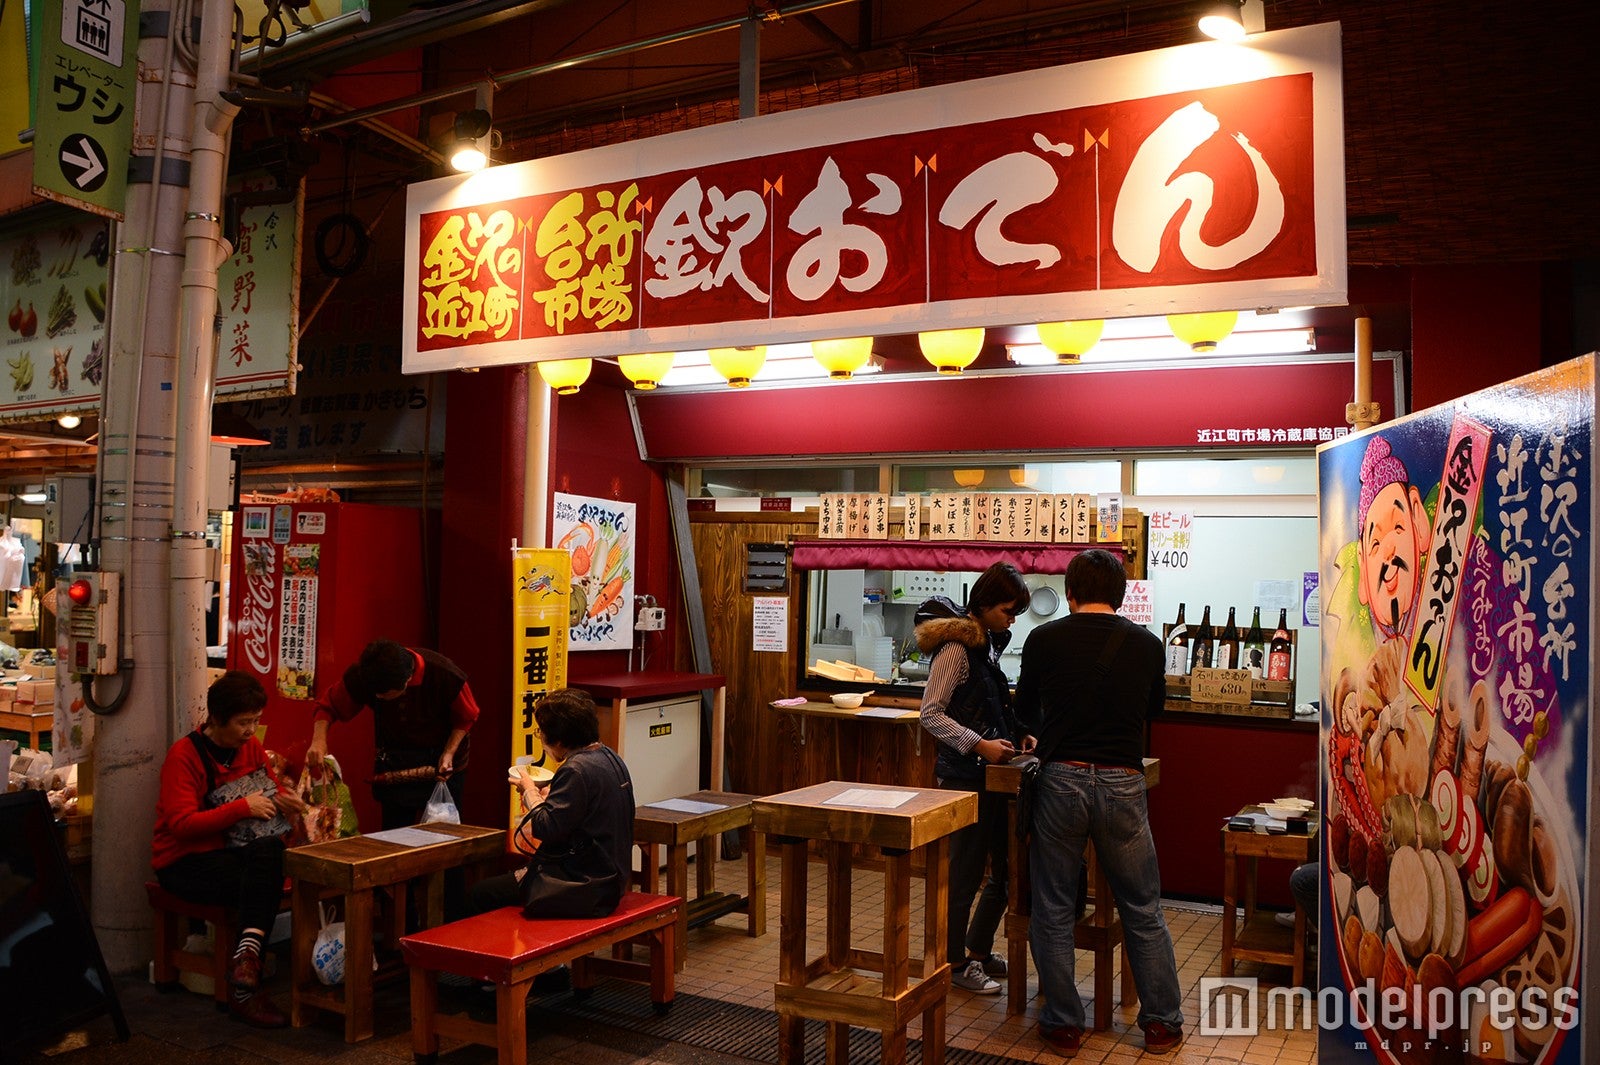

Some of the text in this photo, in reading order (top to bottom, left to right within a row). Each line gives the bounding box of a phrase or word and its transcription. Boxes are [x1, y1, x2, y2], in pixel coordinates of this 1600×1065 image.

[55, 54, 124, 89] エレベーター
[54, 74, 124, 125] ウシ
[644, 101, 1285, 303] 金沢おでん
[264, 211, 279, 251] 金沢
[1197, 426, 1356, 443] 近江町市場冷蔵庫協同
[822, 497, 831, 534] もち巾着
[862, 498, 872, 534] がんも
[876, 497, 886, 532] 牛スジ串
[908, 498, 917, 535] じゃがいも
[932, 498, 942, 534] 大根
[947, 497, 957, 534] ごぼ天
[977, 497, 987, 535] ばい貝
[992, 497, 1002, 535] たけのこ
[1008, 497, 1017, 537] 糸こんにゃく
[1023, 498, 1032, 536] コンニャク
[1040, 498, 1050, 536] 赤巻
[1059, 498, 1069, 536] ちくわ
[1077, 498, 1086, 536] たまご
[1151, 511, 1190, 529] 生ビール
[1151, 551, 1188, 568] ¥400
[1413, 435, 1477, 691] 金沢おでん
[1535, 432, 1582, 681] 金沢の台所
[1492, 434, 1544, 725] 近江町市場
[1118, 603, 1152, 613] できます!!
